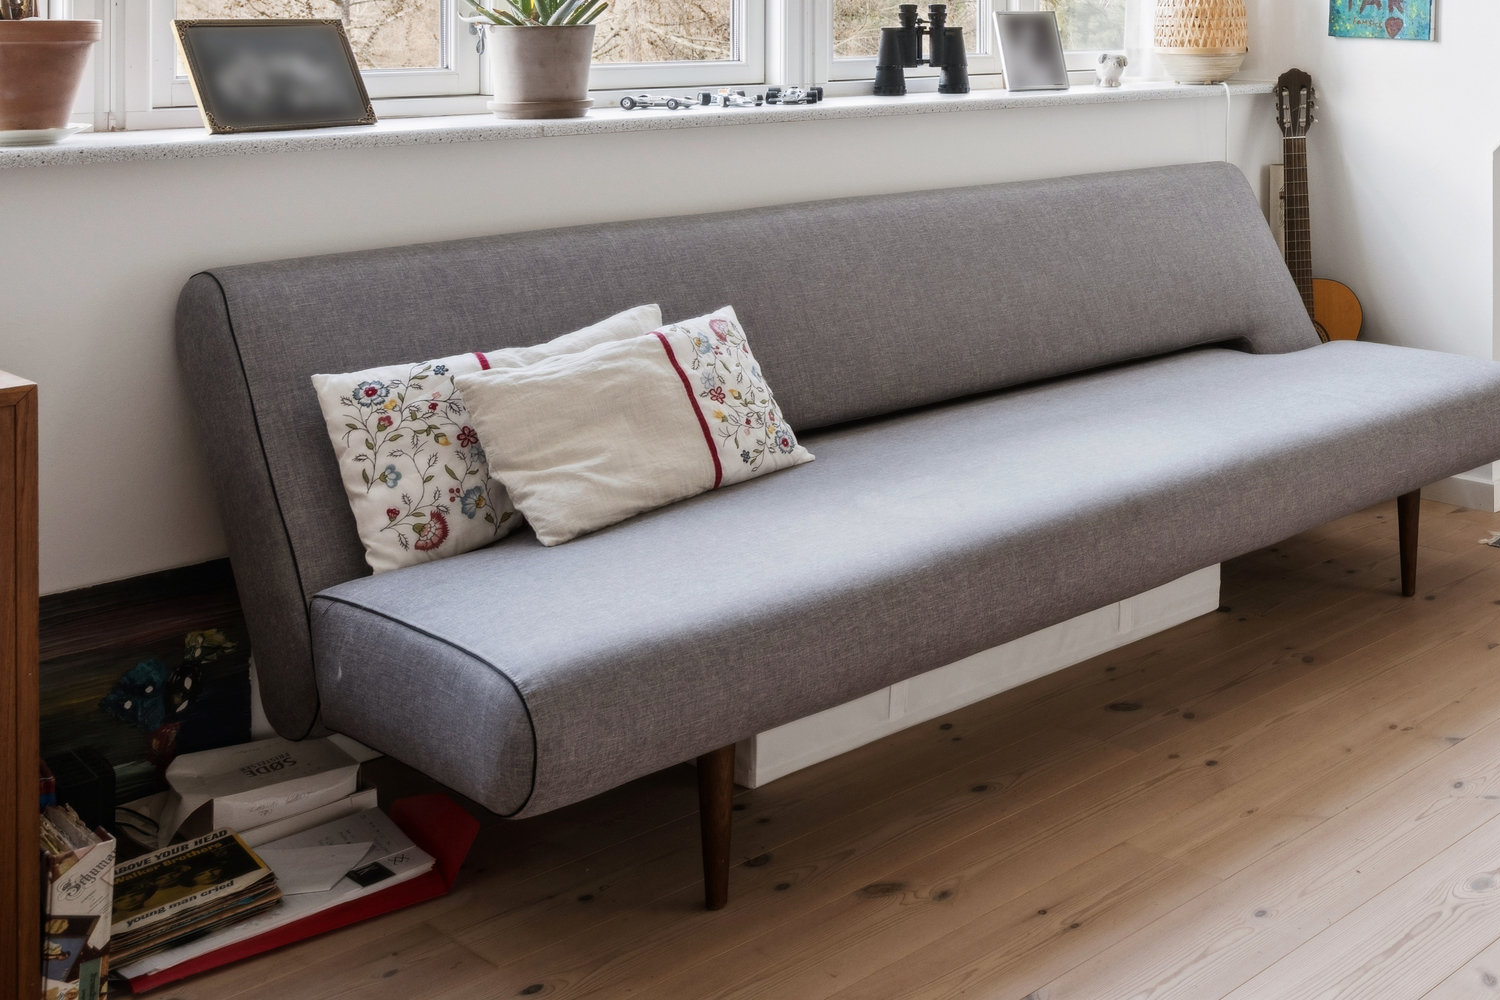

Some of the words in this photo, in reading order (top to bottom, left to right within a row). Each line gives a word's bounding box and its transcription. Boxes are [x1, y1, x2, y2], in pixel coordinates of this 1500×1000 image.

[243, 756, 298, 779] SØDE
[154, 843, 191, 863] YOUR
[193, 829, 229, 847] HEAD
[164, 841, 223, 866] Brothers
[126, 906, 167, 928] young
[168, 896, 198, 911] man
[200, 880, 235, 898] cried
